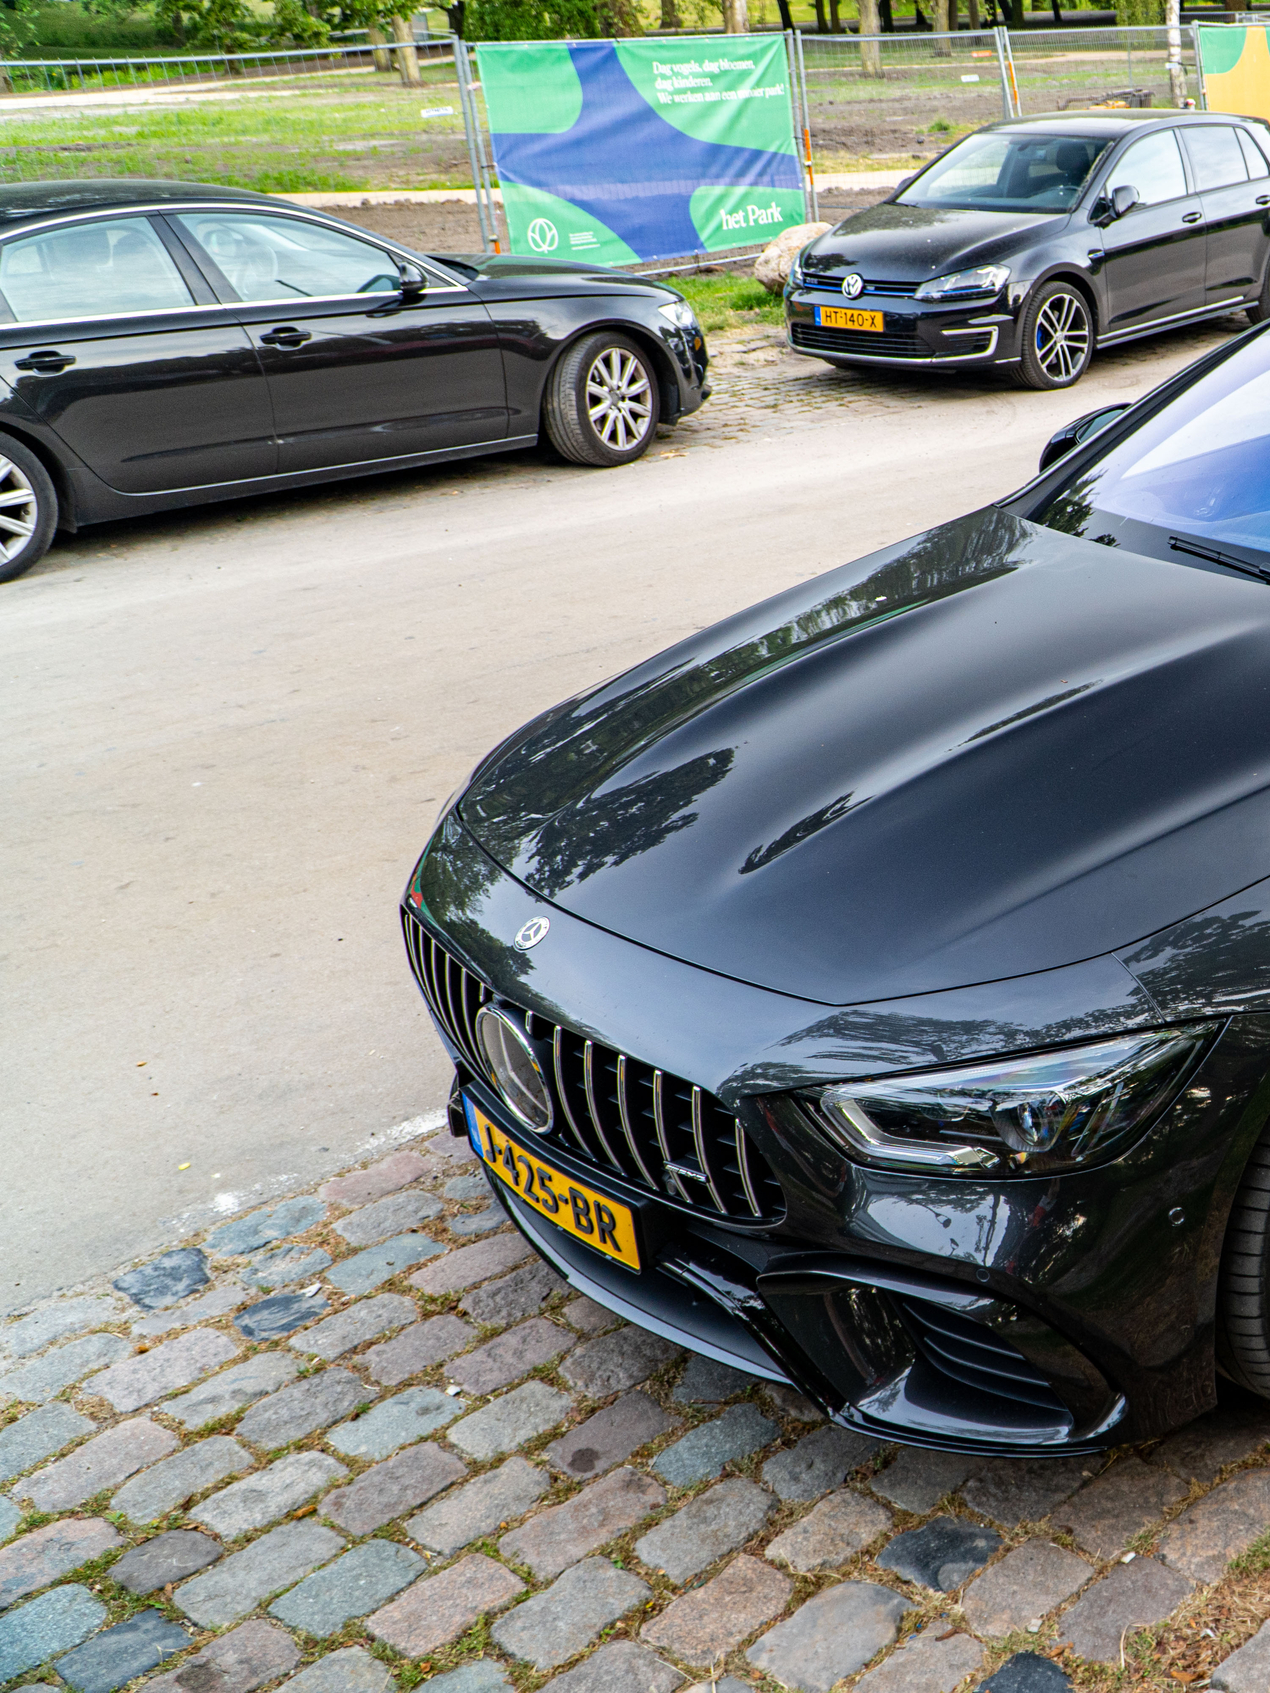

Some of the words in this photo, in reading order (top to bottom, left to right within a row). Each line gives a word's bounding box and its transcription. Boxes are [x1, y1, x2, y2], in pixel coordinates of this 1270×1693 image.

[652, 61, 672, 76] Dag
[702, 60, 720, 74] dag
[655, 76, 673, 92] dag
[657, 92, 672, 104] We
[673, 91, 704, 103] werken
[705, 92, 720, 102] aan
[722, 91, 737, 100] een
[765, 83, 785, 99] park!
[720, 209, 746, 230] het
[747, 202, 783, 226] Park
[825, 311, 877, 328] HT-140-X
[485, 1124, 622, 1252] J-425-BR
